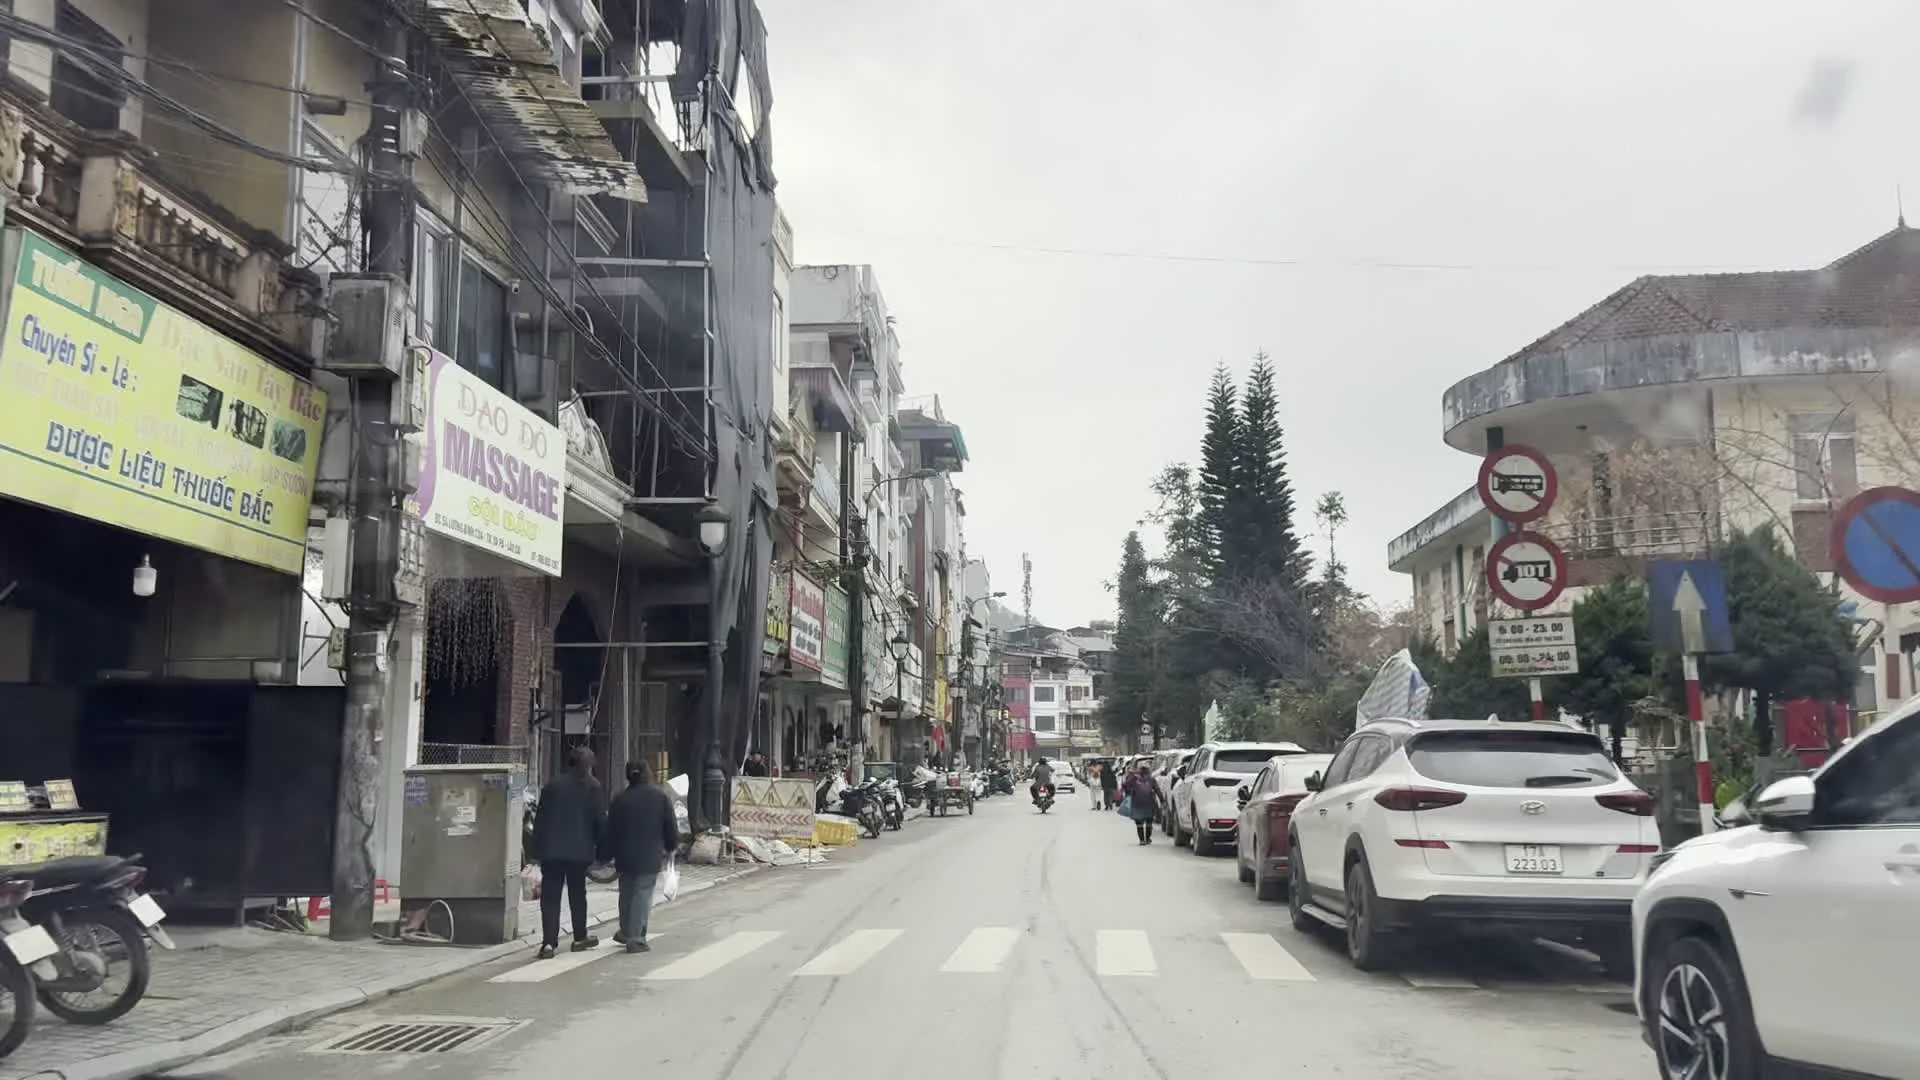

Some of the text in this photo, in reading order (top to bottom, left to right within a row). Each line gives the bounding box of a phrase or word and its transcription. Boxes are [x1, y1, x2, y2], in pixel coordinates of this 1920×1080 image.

[119, 447, 166, 489] LIỆU
[172, 466, 236, 512] THUỐC
[239, 489, 274, 526] BẮC
[442, 417, 559, 521] MASSAGE
[1515, 564, 1548, 578] 10T
